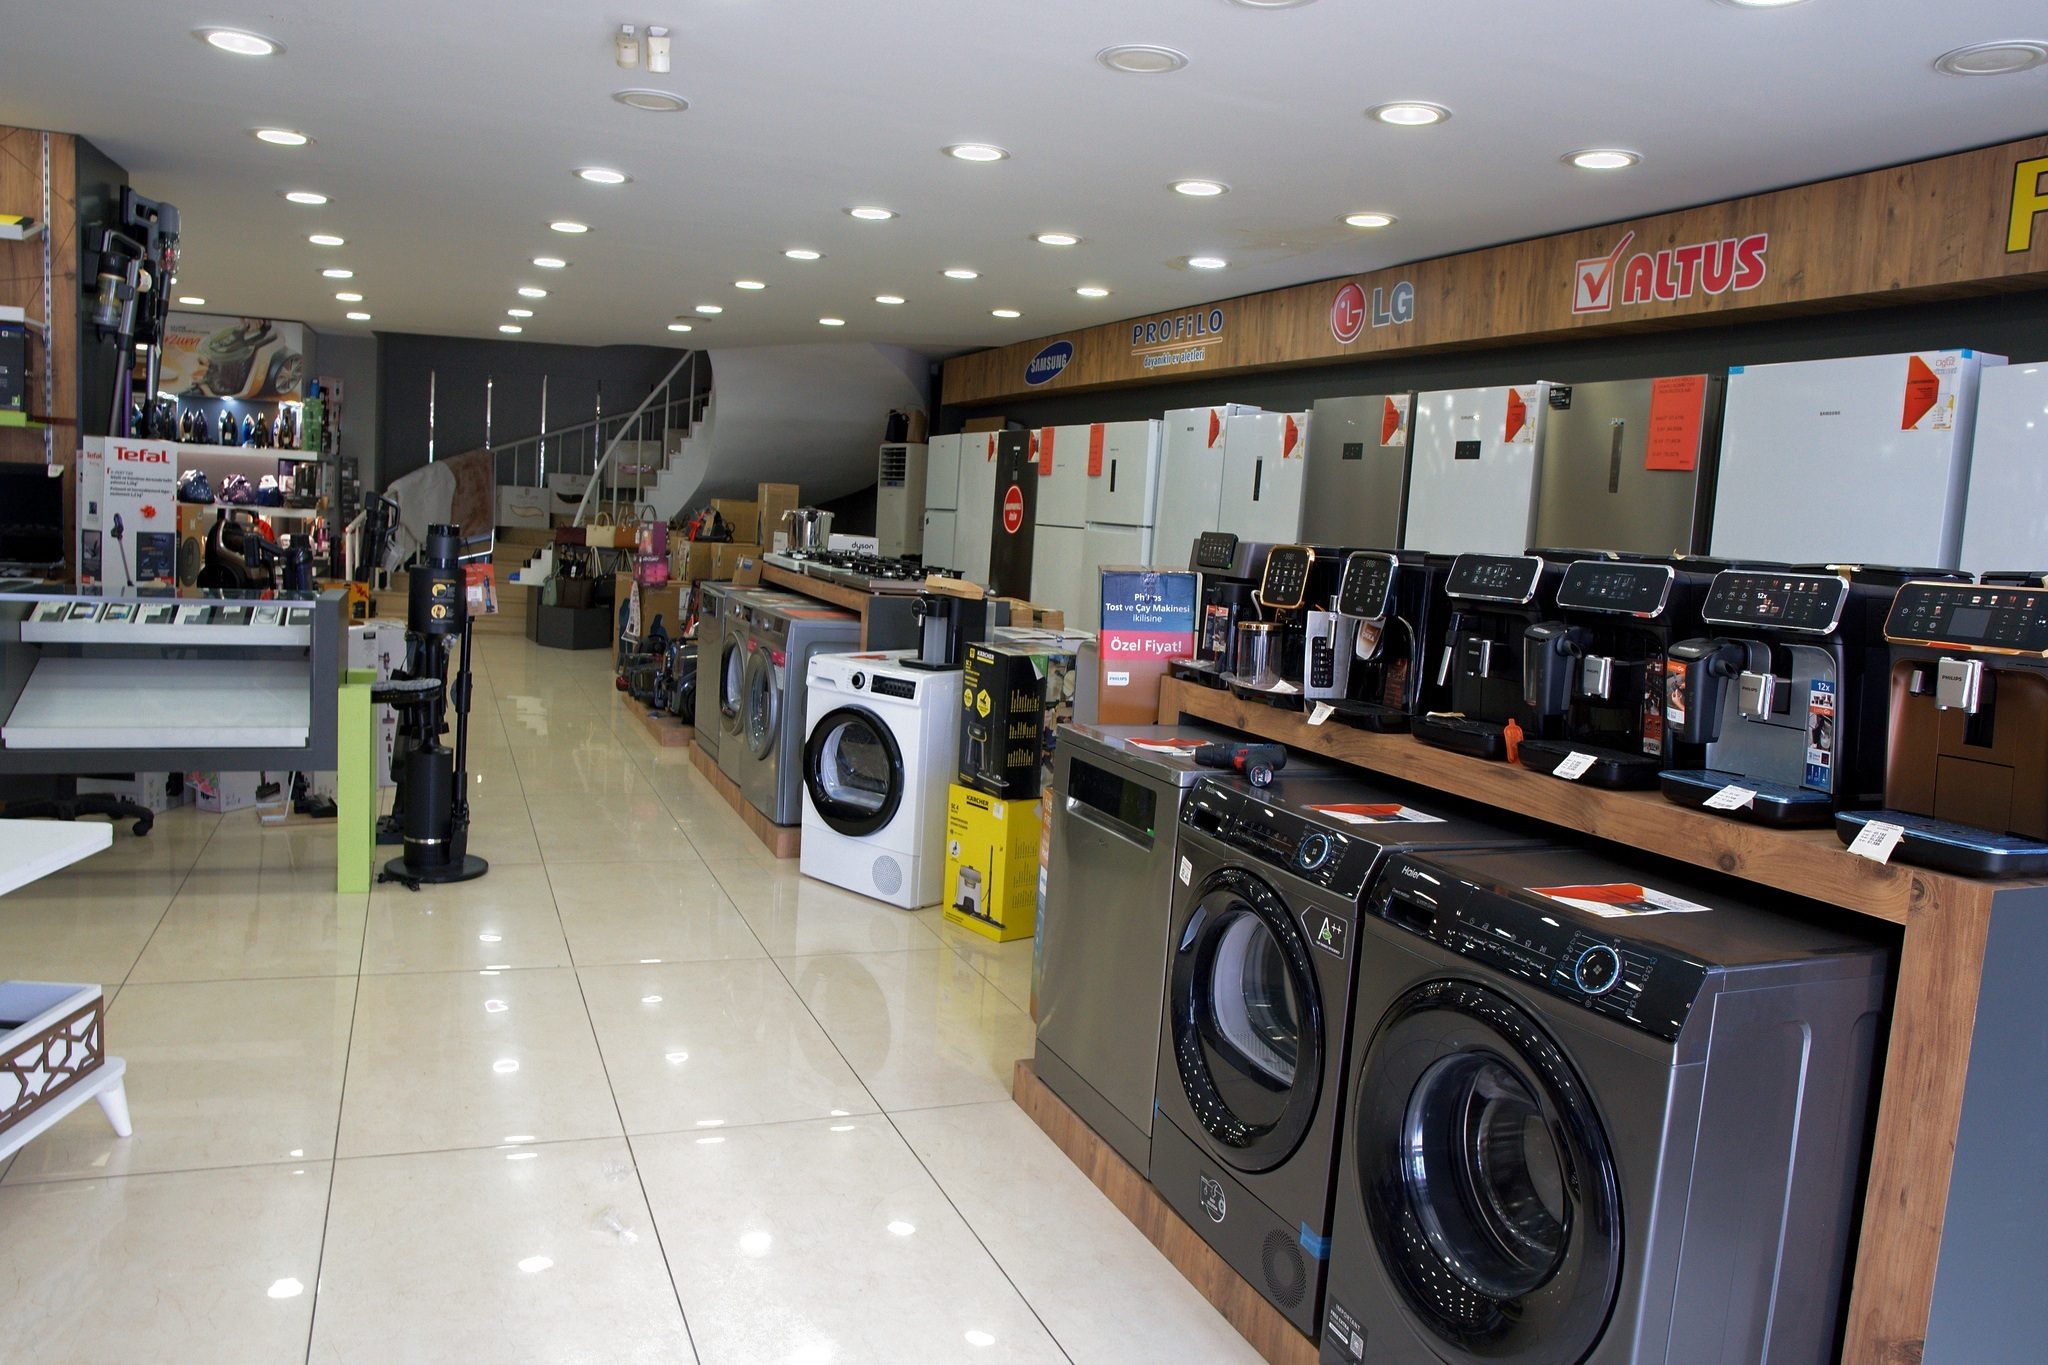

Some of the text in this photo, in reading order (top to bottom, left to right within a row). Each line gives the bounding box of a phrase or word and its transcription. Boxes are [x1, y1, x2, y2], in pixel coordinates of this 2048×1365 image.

[1621, 233, 1768, 305] ALTUS
[1373, 281, 1414, 328] LG
[1031, 353, 1068, 373] SAMSUNG
[1181, 347, 1205, 363] aletleri
[113, 446, 170, 464] Tefal
[851, 541, 874, 550] dyson
[1106, 603, 1123, 612] Tost
[1135, 603, 1151, 615] Çay
[1152, 604, 1190, 613] Makinesi
[1110, 636, 1183, 655] Özel Fiyat!
[1817, 682, 1831, 692] 12x
[1941, 674, 1962, 682] PHILIPS
[1401, 865, 1420, 880] Haier
[1318, 916, 1342, 945] A++
[1335, 1303, 1361, 1331] IMPORTANT
